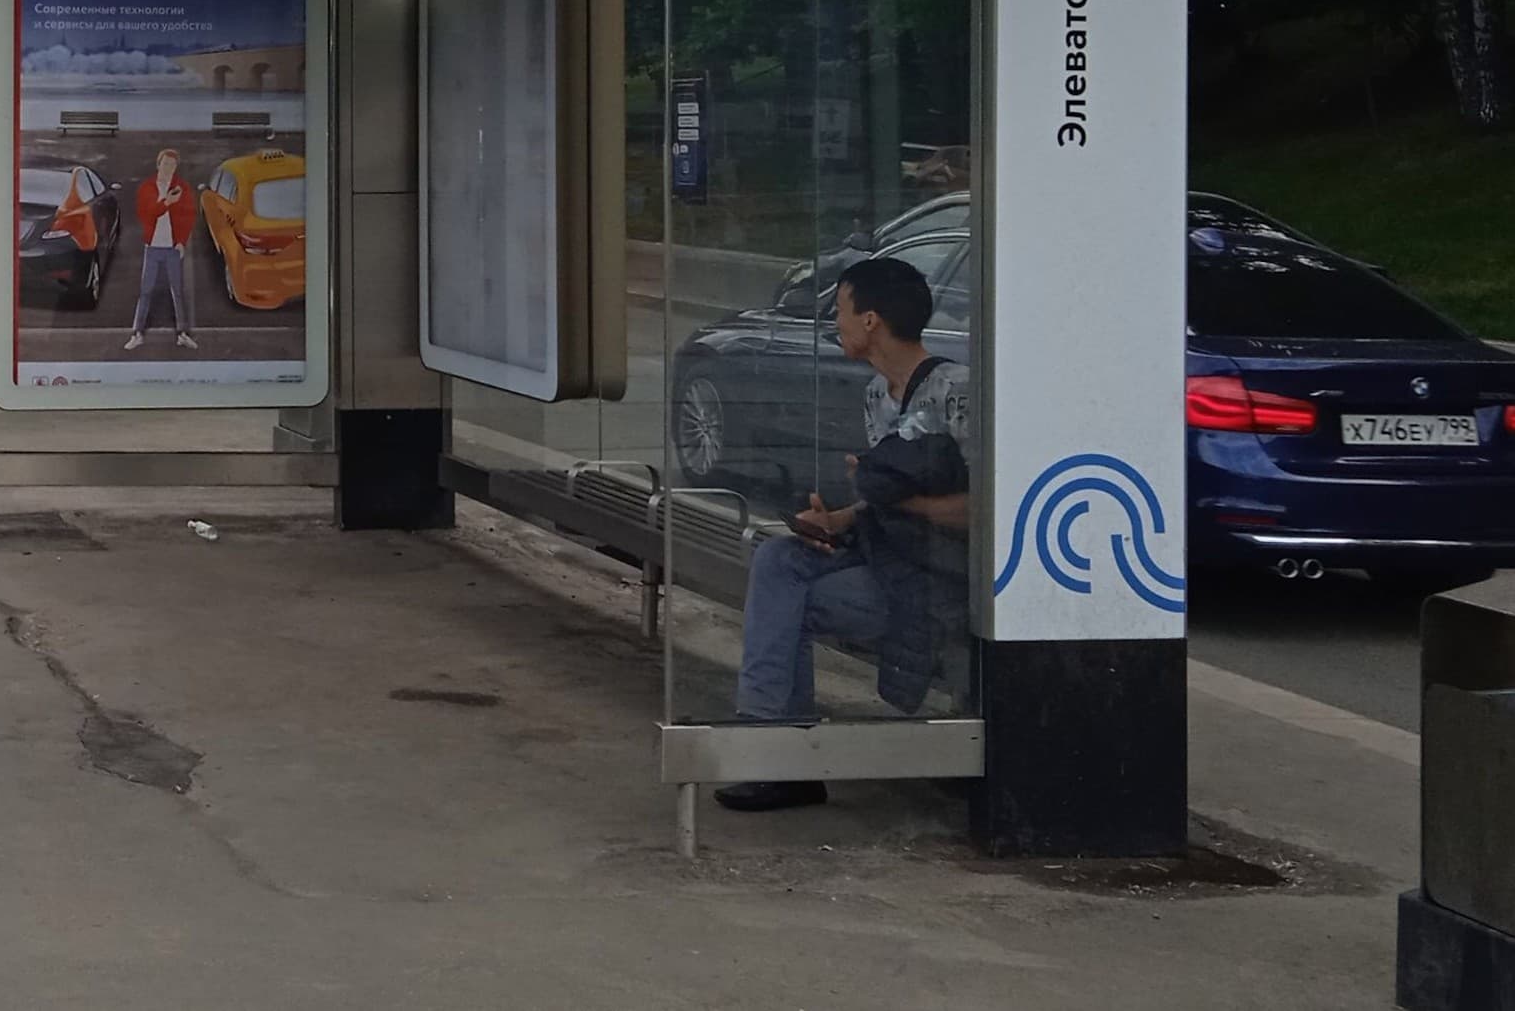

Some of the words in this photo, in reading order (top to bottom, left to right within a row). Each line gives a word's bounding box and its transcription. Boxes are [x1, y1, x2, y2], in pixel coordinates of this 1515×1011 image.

[34, 2, 117, 17] Современные
[119, 5, 185, 16] технологии
[44, 20, 93, 32] сервисы
[118, 21, 159, 31] вашего
[161, 19, 213, 33] удобства
